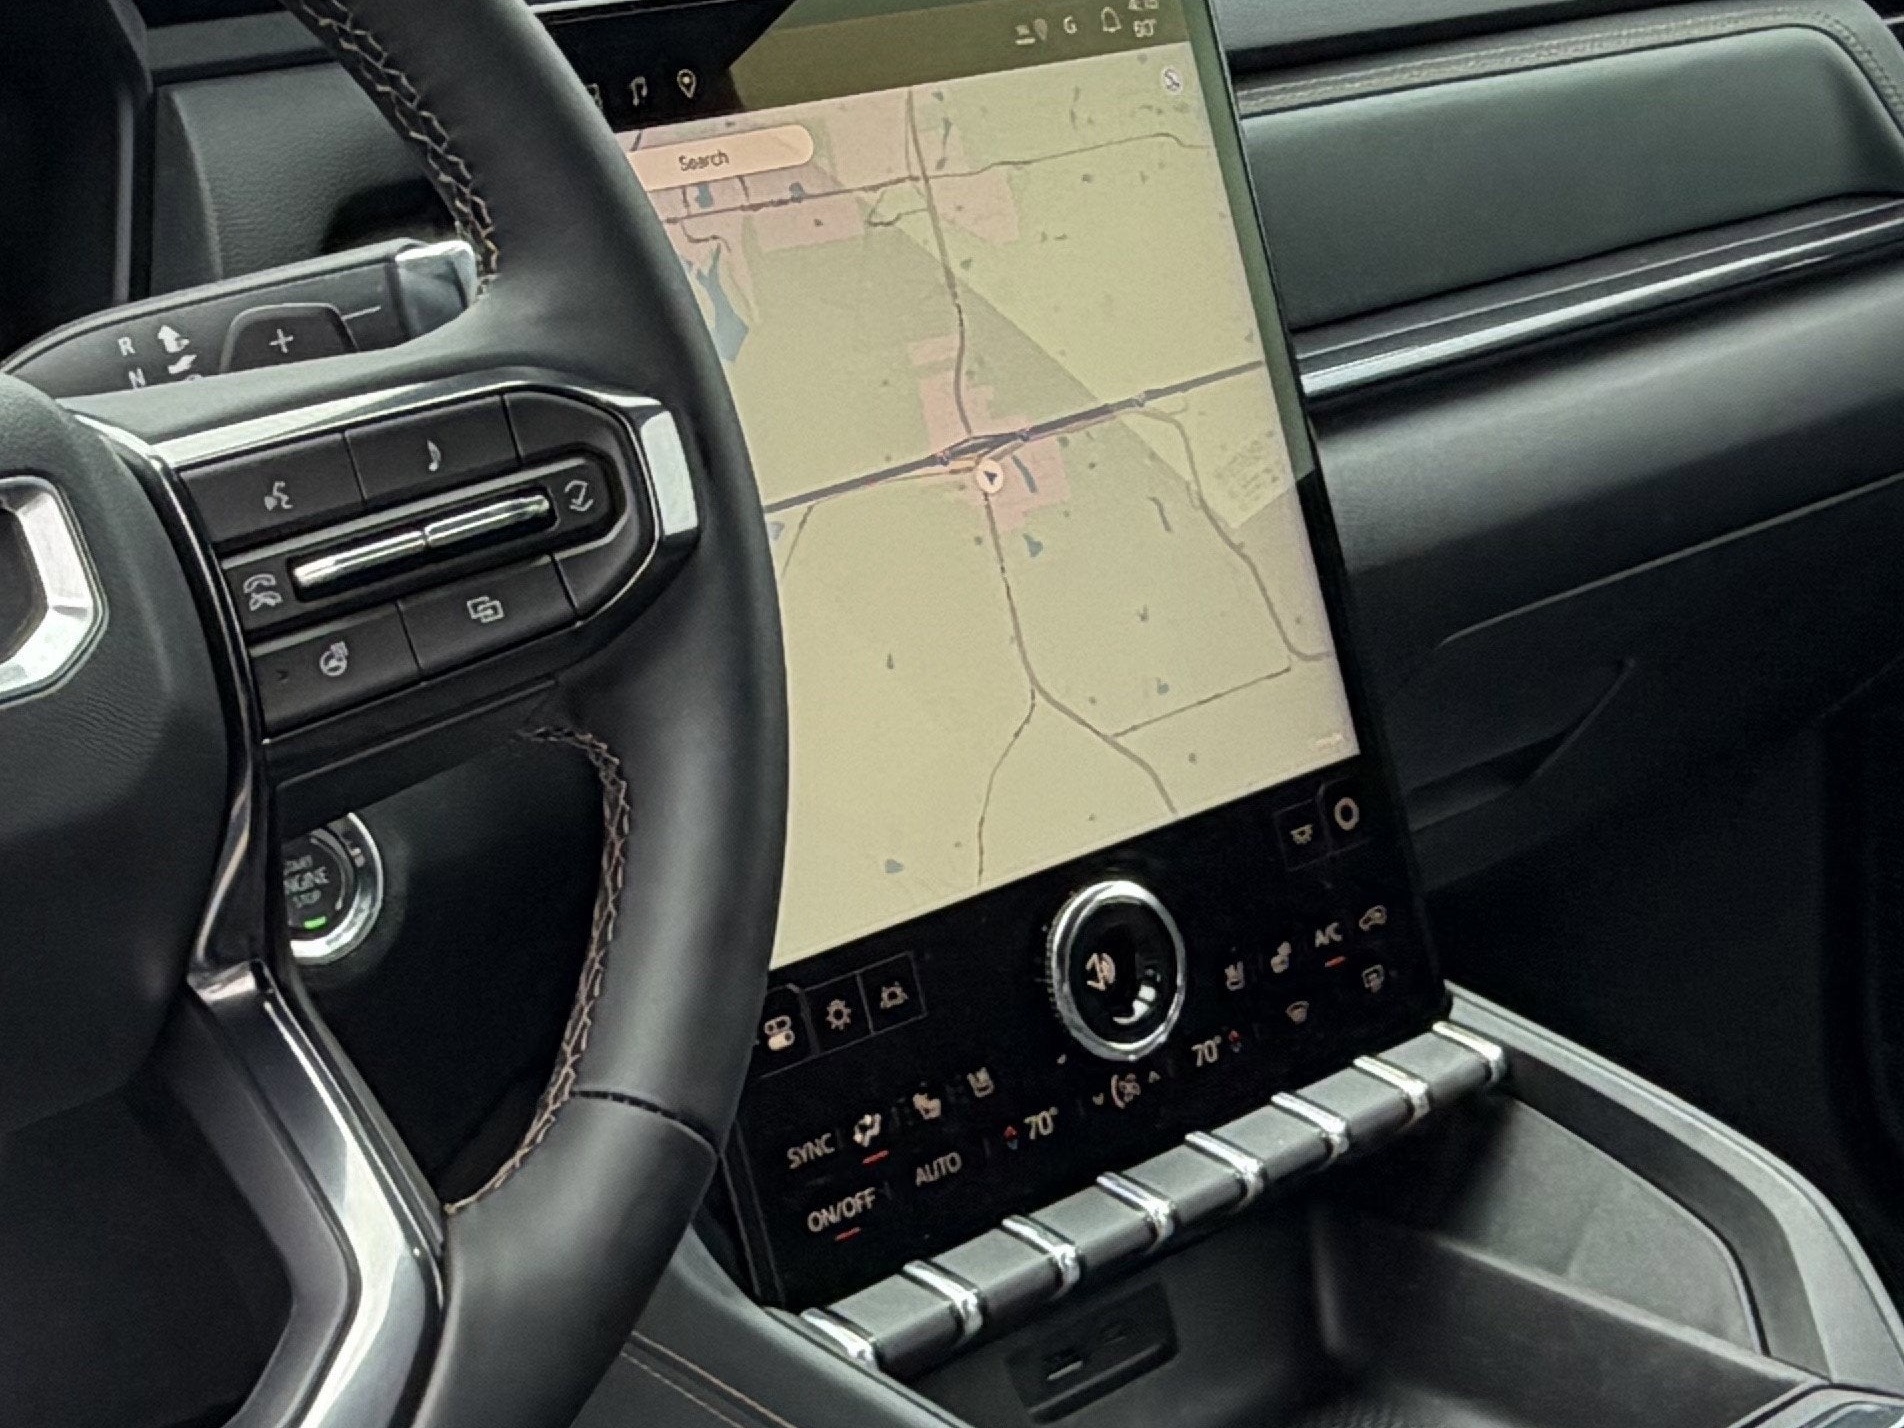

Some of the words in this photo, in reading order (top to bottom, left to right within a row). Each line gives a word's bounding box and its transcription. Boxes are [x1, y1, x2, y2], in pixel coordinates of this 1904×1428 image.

[677, 149, 730, 172] Search
[117, 336, 136, 357] R
[127, 368, 147, 390] N
[1023, 1106, 1059, 1140] 70°
[786, 1132, 836, 1170] SYNC
[914, 1151, 963, 1188] AUTO
[805, 1185, 876, 1234] ON/OFF
